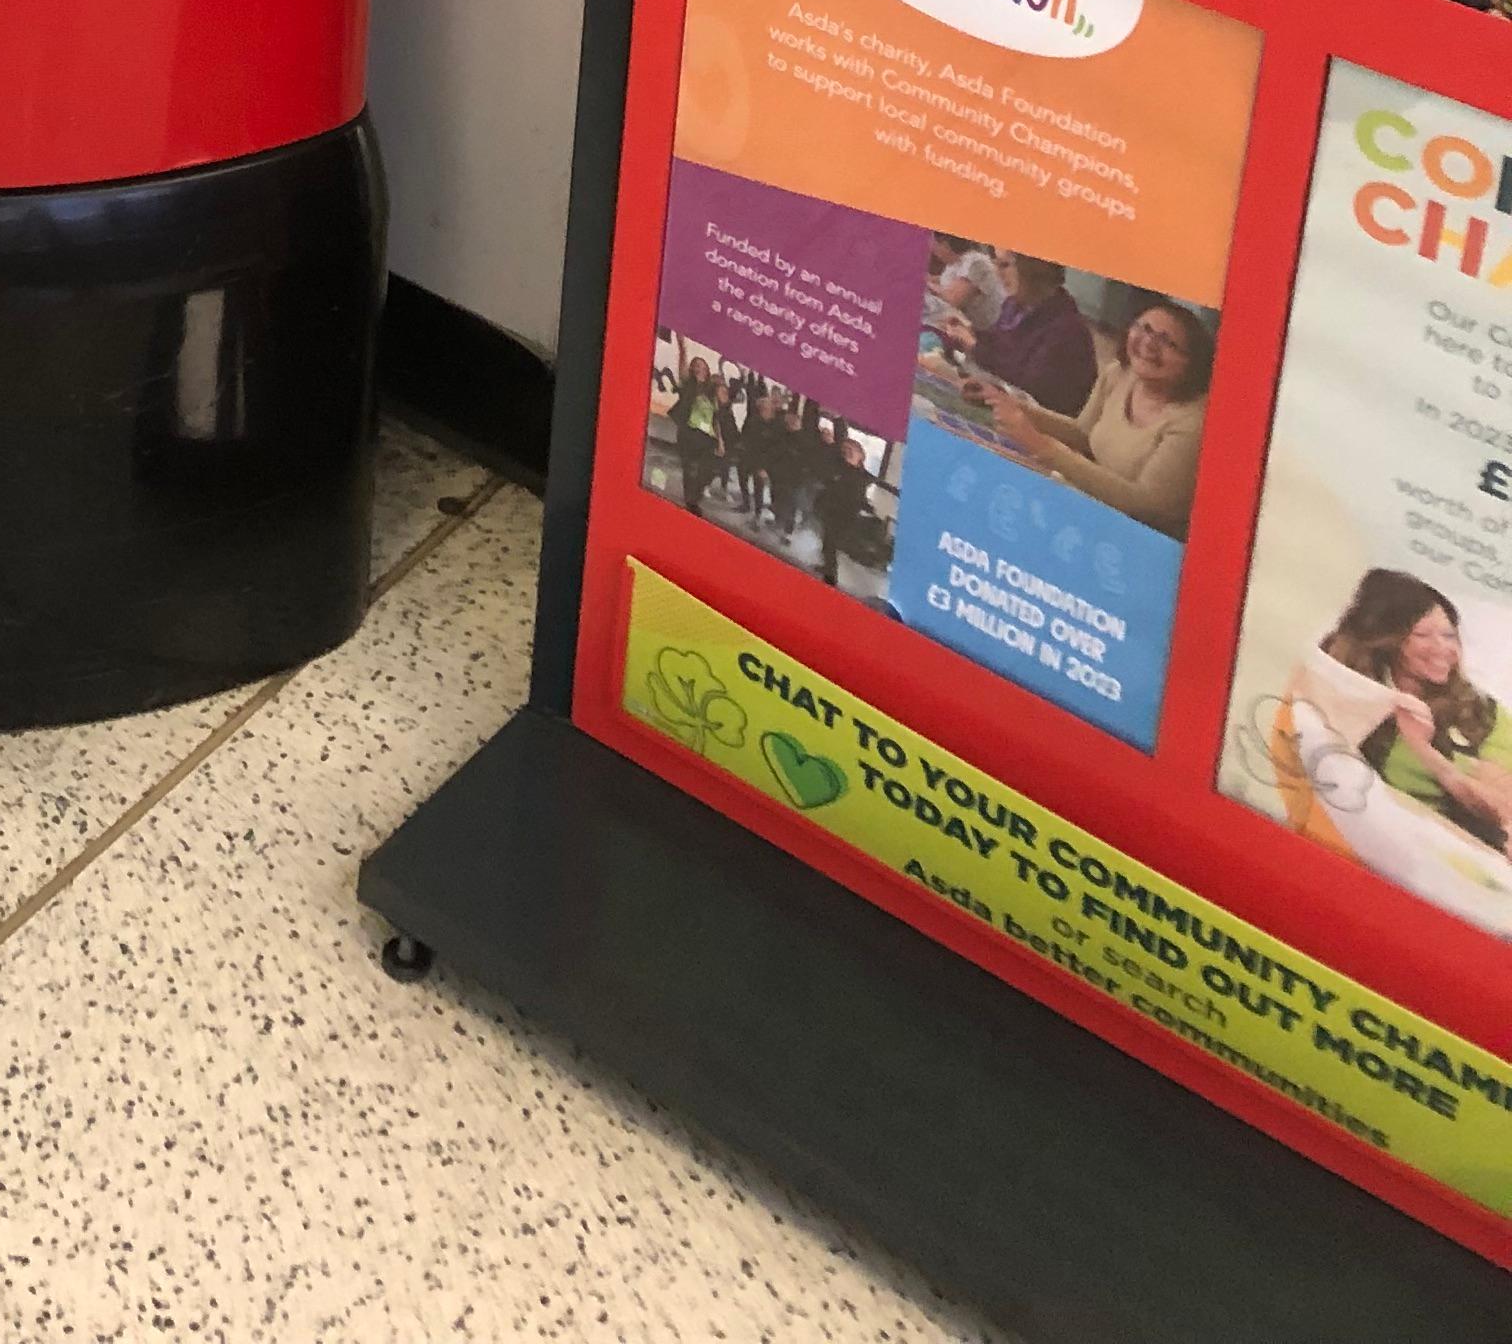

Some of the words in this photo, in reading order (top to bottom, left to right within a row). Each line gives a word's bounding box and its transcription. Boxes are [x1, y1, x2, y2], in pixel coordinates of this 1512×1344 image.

[767, 26, 827, 62] works
[833, 52, 876, 80] with
[881, 69, 1003, 137] Community
[767, 52, 788, 73] to
[793, 64, 872, 110] support
[879, 95, 928, 131] local
[933, 124, 1052, 188] community
[1057, 176, 1137, 221] groups
[788, 1, 854, 43] Asda's
[939, 63, 994, 100] Asda
[1000, 86, 1127, 155] Foundation
[875, 127, 918, 158] with
[1354, 108, 1512, 216] CO
[1353, 181, 1512, 291] CH
[737, 652, 843, 729] CHAT
[852, 717, 908, 769] TO
[919, 756, 1039, 849] YOUR
[1048, 837, 1341, 1013] COMMUNITY
[858, 759, 1000, 859] TODAY
[1009, 850, 1071, 902] TO
[1081, 891, 1189, 970] FIND
[1200, 963, 1303, 1033] OUT
[1312, 1023, 1461, 1121] MORE
[904, 858, 992, 922] Asda
[1004, 912, 1122, 994] better
[1130, 992, 1391, 1149] communities
[1051, 915, 1091, 946] or
[1102, 945, 1228, 1029] search
